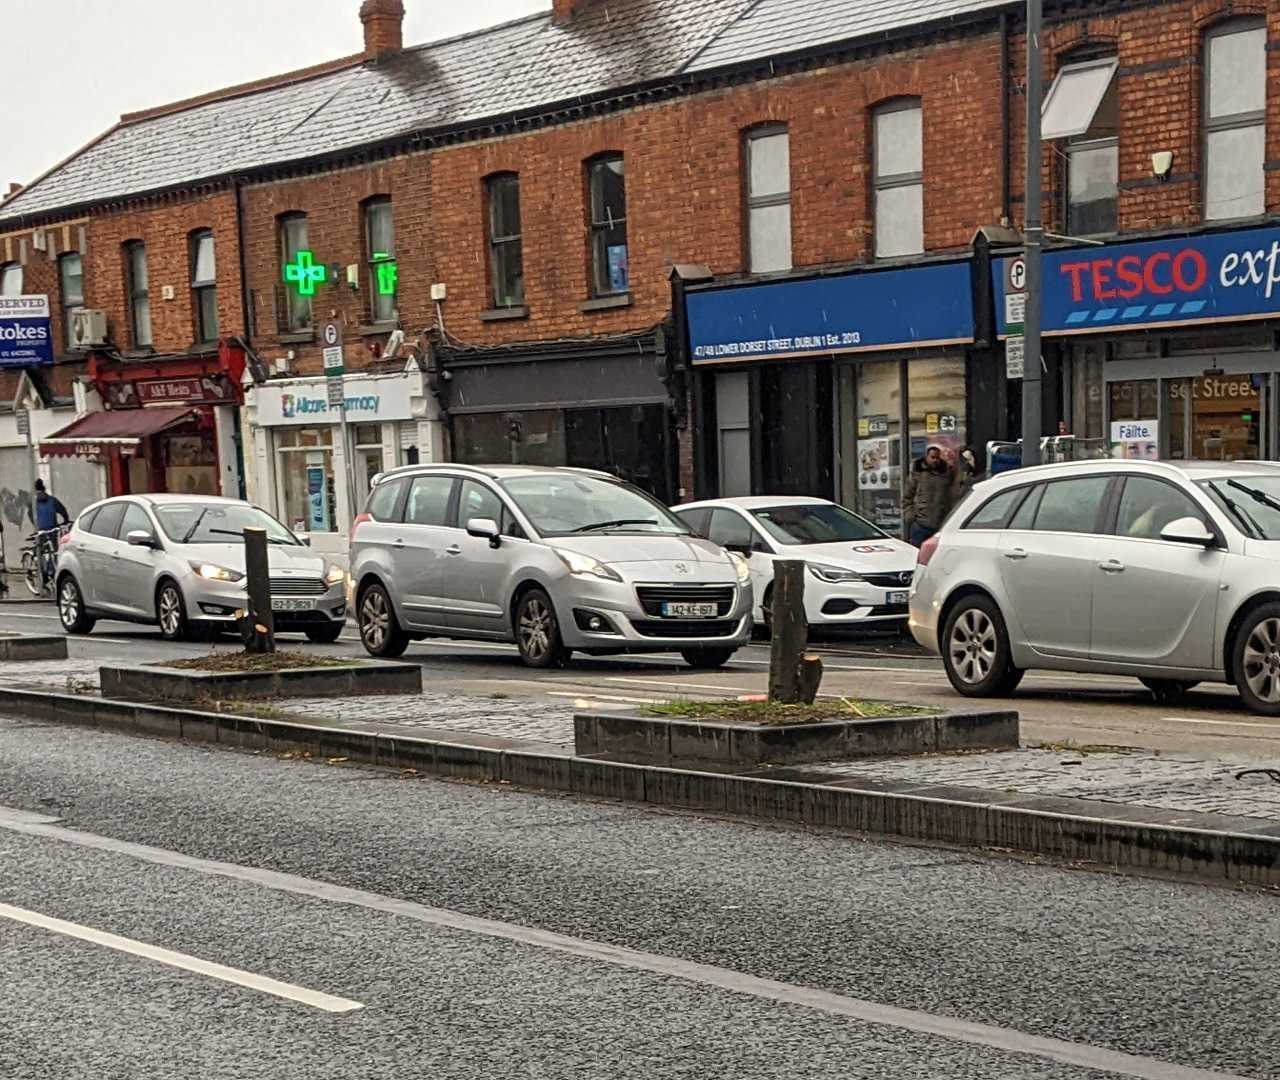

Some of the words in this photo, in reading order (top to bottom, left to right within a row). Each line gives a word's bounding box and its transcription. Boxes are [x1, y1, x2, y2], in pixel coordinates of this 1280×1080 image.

[1060, 248, 1207, 302] TESCO
[715, 343, 739, 355] LOWER
[740, 340, 766, 353] DORSET
[795, 336, 821, 348] DUBLIN
[842, 332, 861, 344] 2013
